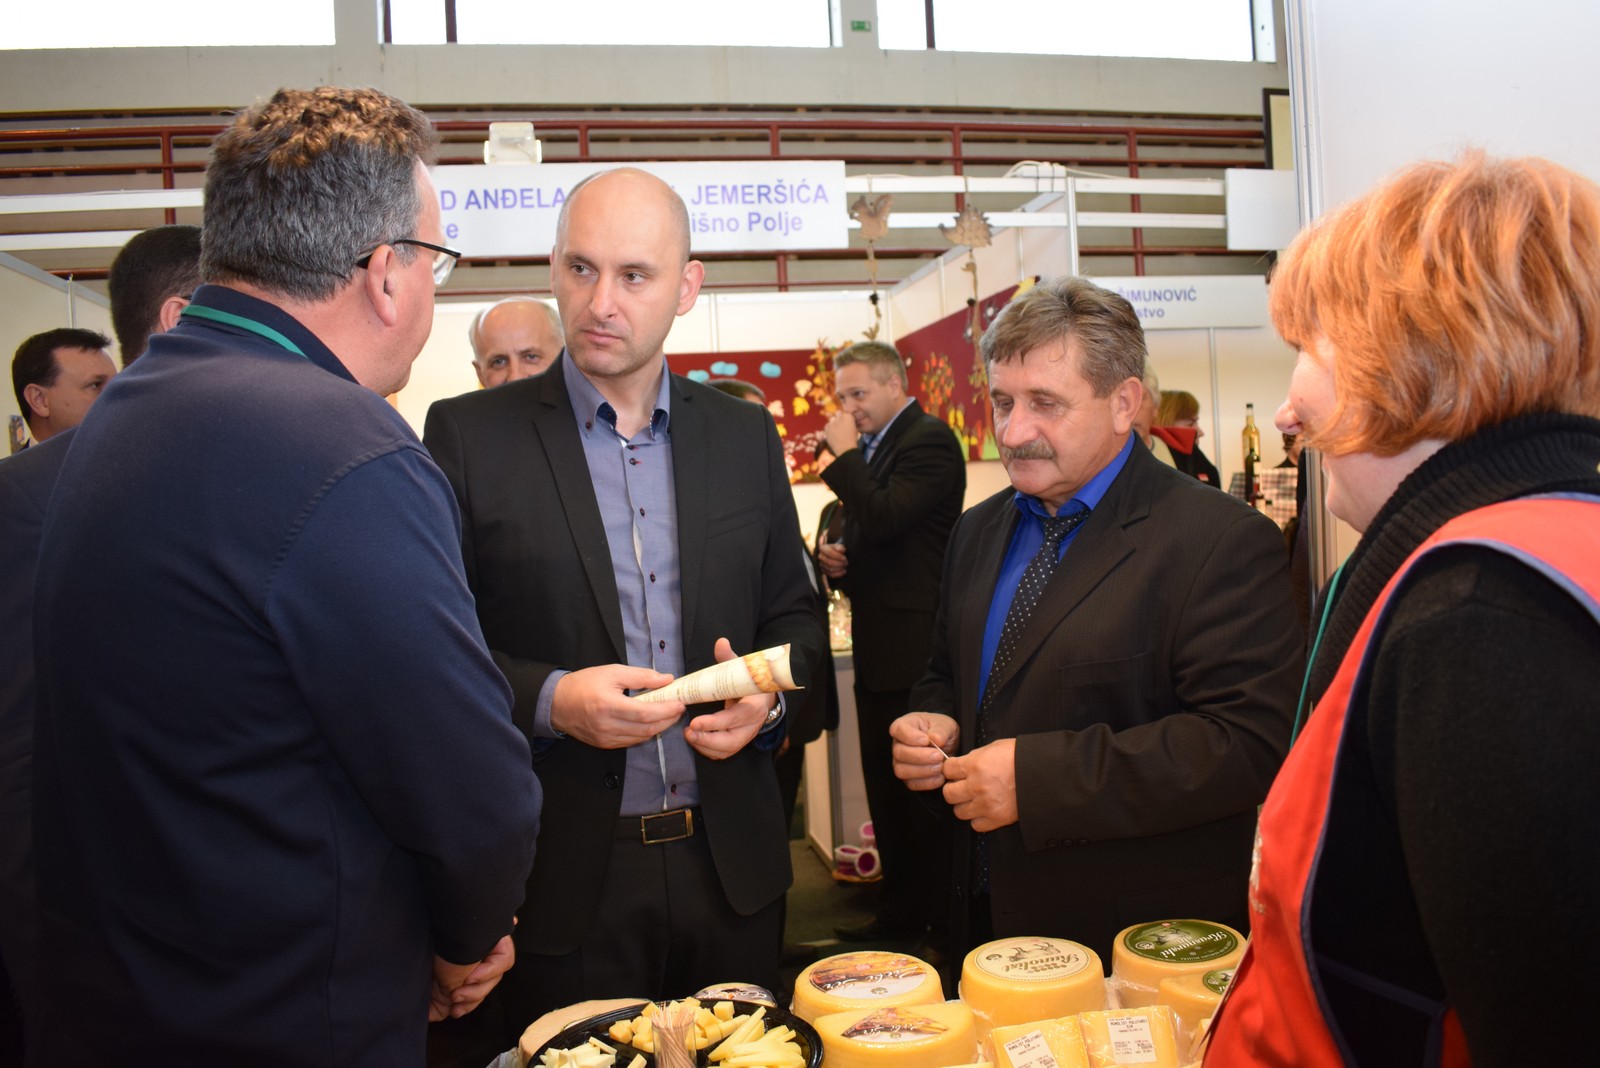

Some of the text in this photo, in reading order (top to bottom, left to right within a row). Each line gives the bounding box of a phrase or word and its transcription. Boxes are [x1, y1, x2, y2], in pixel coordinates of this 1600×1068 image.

[465, 187, 567, 210] ANĐELA
[690, 178, 829, 205] JEMERŠIĆA
[690, 211, 803, 237] išno Polje
[1135, 307, 1165, 318] stvo
[1002, 953, 1080, 972] Runolist
